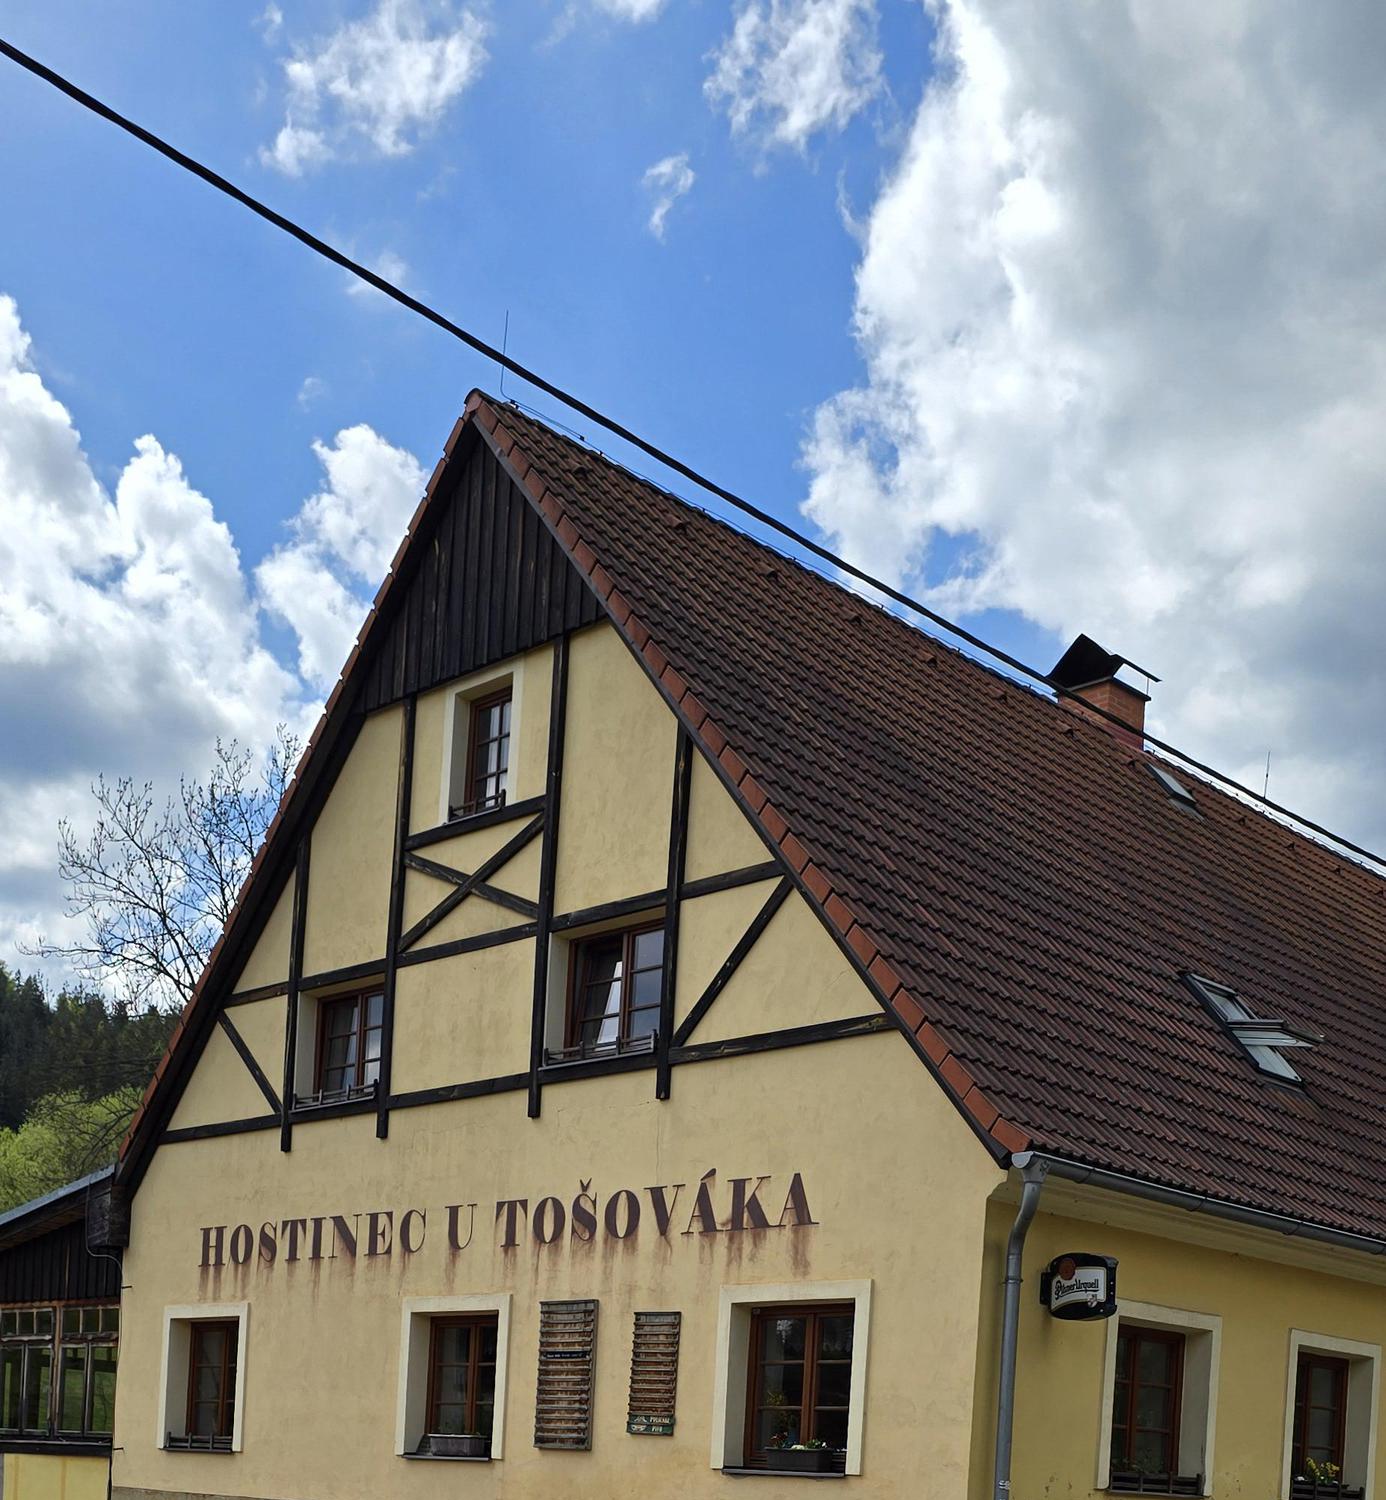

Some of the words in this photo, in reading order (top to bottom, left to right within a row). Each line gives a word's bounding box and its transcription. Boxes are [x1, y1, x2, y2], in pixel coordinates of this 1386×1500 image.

[199, 1209, 427, 1268] HOSTINEC
[445, 1203, 478, 1250] U
[496, 1168, 820, 1248] TOŠOVÁKA
